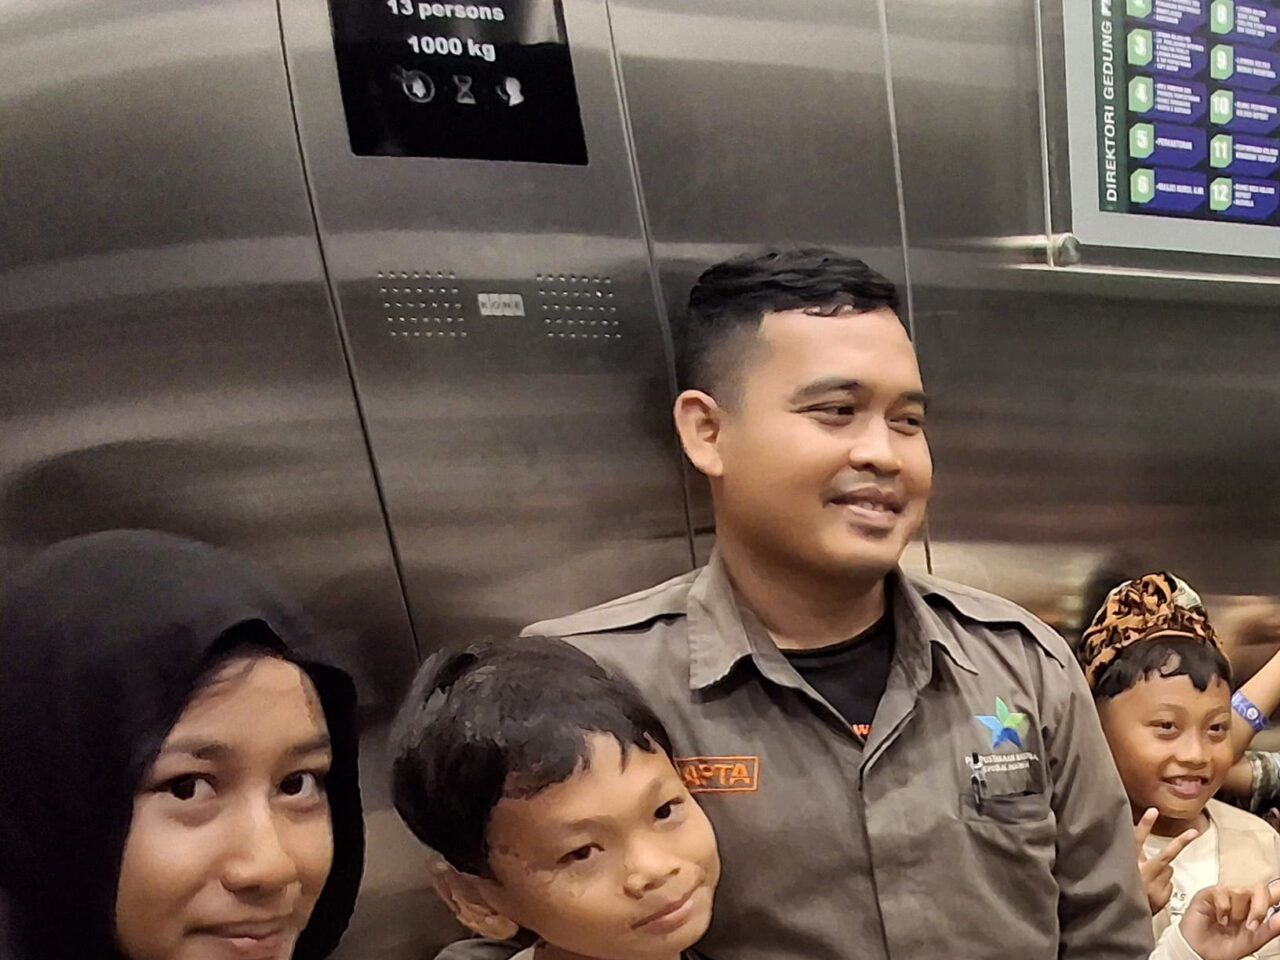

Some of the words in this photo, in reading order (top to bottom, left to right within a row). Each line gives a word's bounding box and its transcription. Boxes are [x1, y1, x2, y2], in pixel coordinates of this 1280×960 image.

[418, 3, 505, 20] persons
[408, 35, 463, 55] 1000
[467, 38, 496, 61] kg
[1135, 34, 1147, 56] 3
[1101, 20, 1114, 99] GEDUNG
[1136, 129, 1148, 149] 5
[1214, 140, 1228, 159] 11
[1104, 105, 1117, 201] DIREKTORI
[1137, 174, 1149, 195] 6
[1212, 184, 1229, 202] 12
